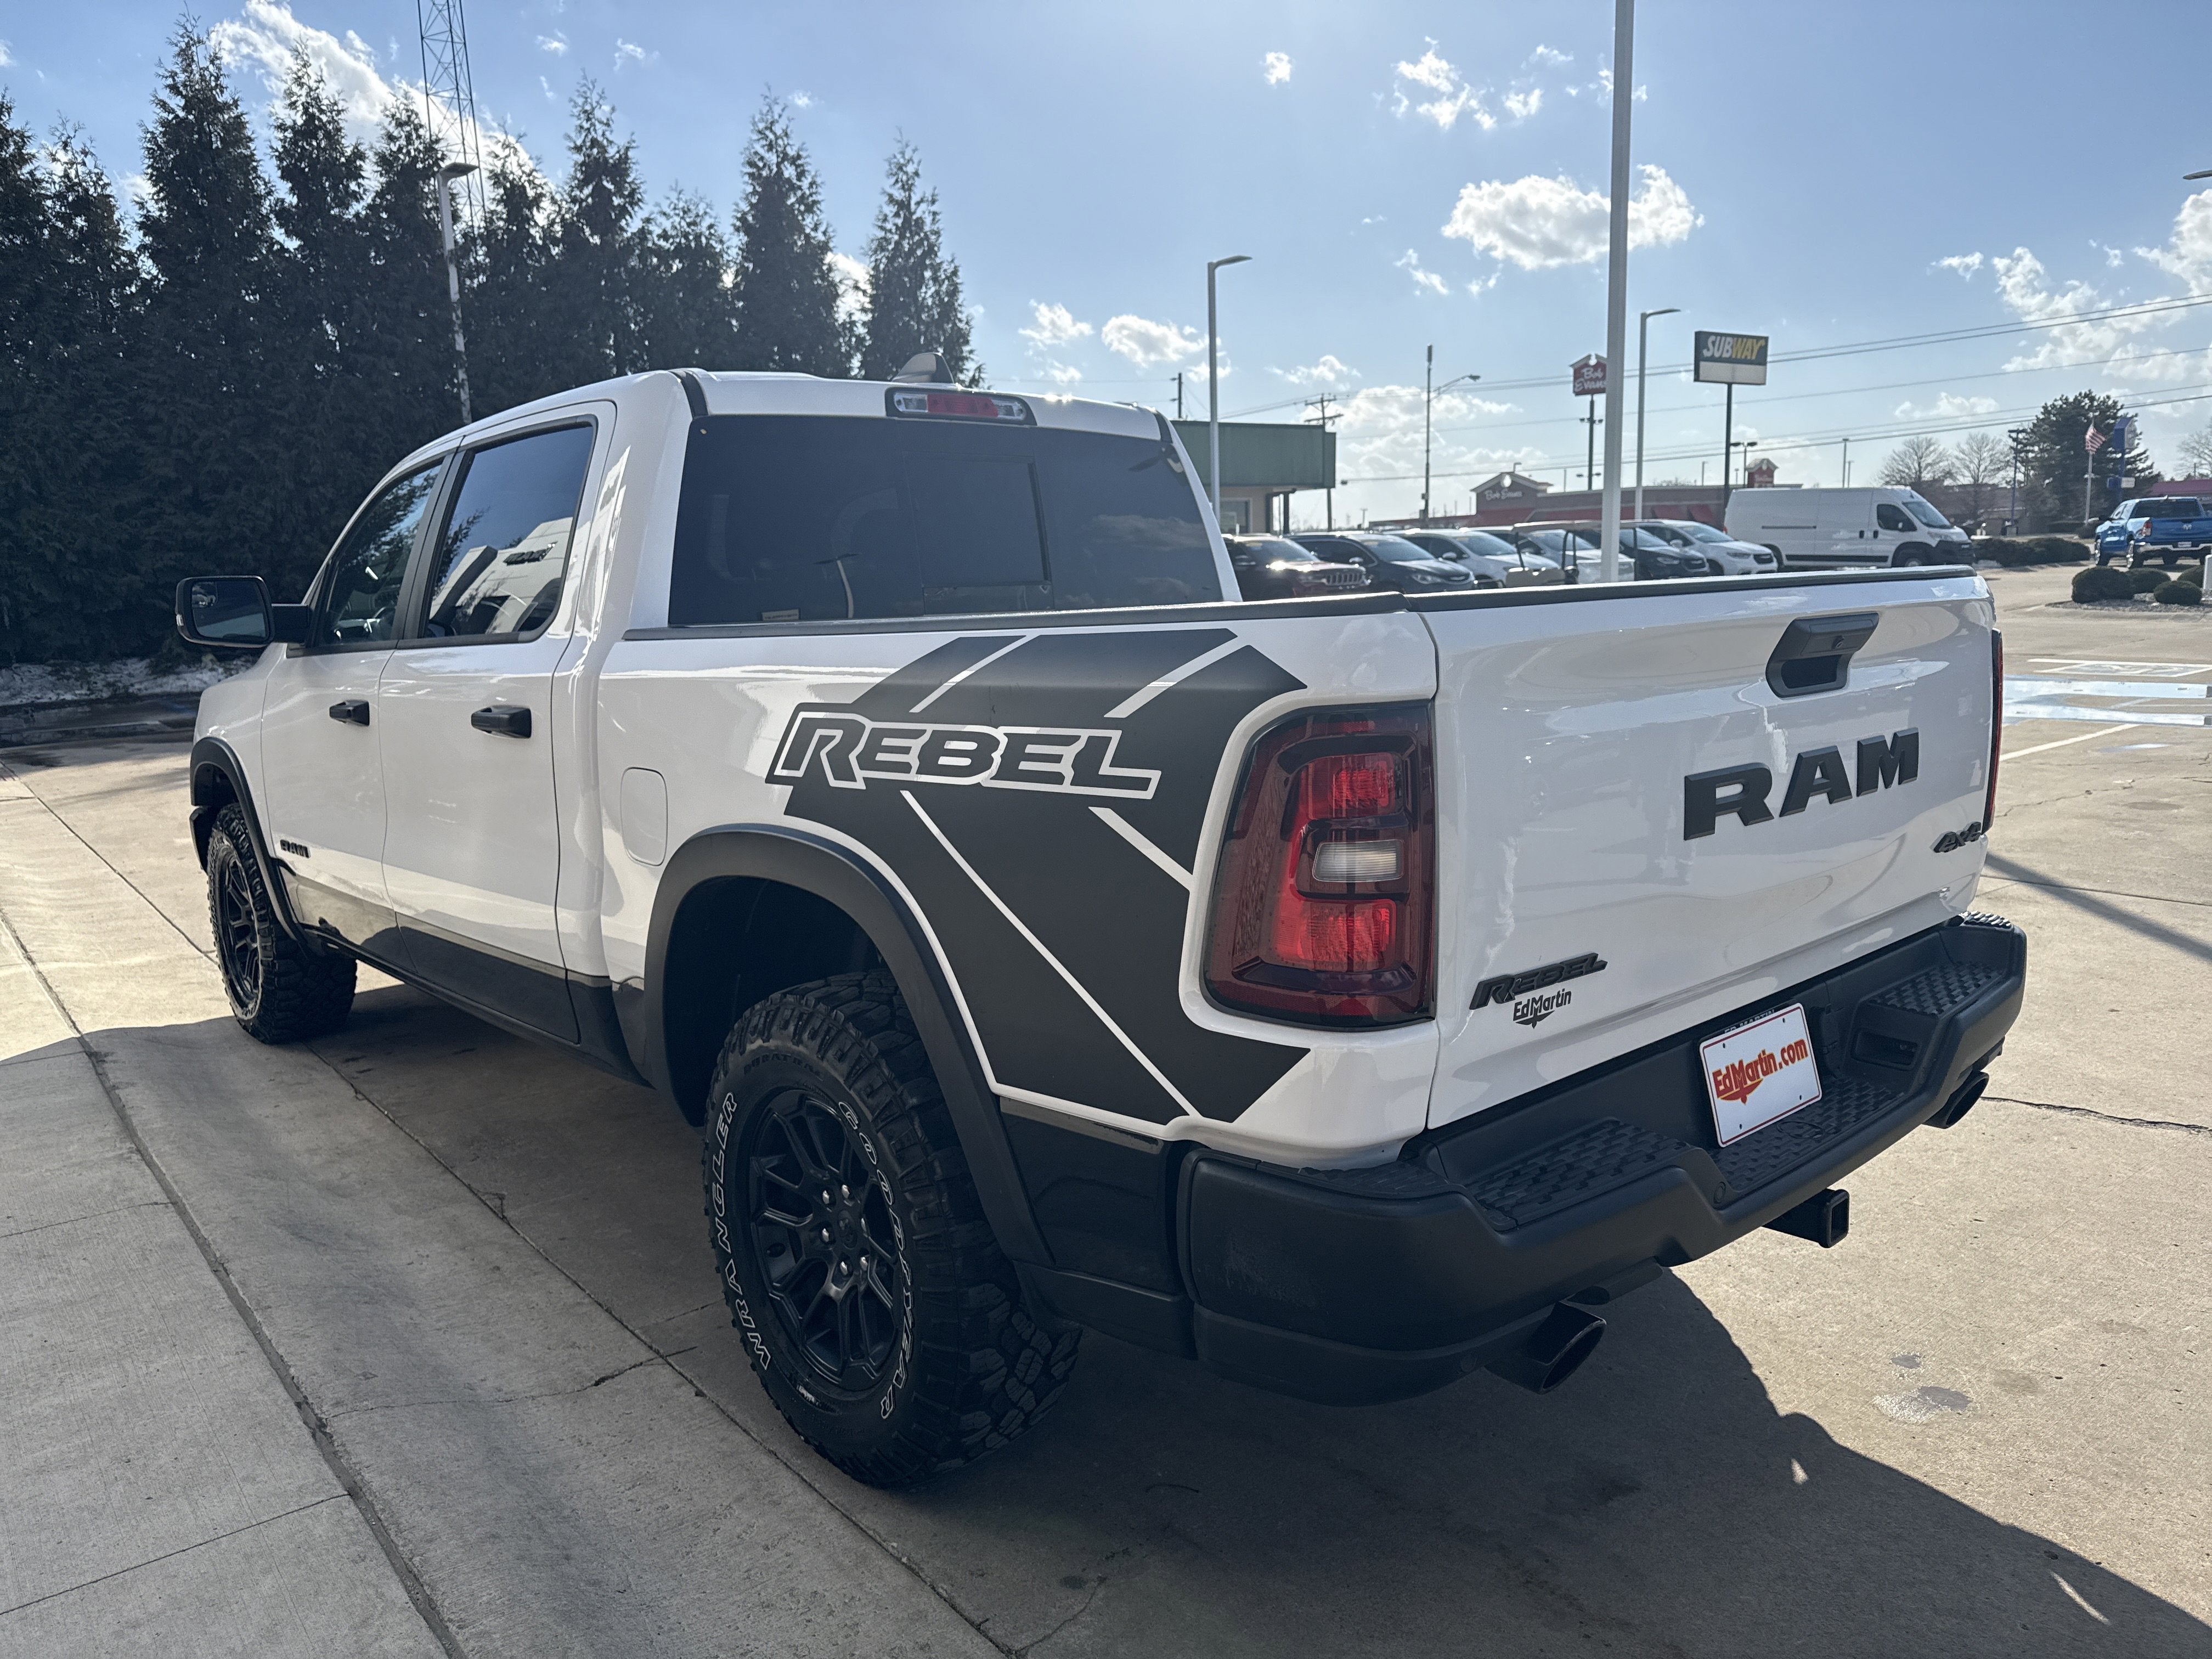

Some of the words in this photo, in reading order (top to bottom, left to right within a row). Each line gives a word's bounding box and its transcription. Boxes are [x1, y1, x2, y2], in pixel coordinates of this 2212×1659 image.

[1581, 367, 1603, 379] Bob
[1703, 335, 1765, 360] SUBWAY
[1485, 489, 1500, 500] Bob
[774, 711, 1162, 800] REBEL
[1684, 727, 1919, 841] RAM
[280, 839, 311, 859] RAM
[1469, 952, 1608, 1010] REBEL
[1513, 988, 1572, 1022] EdMartin
[1712, 1039, 1809, 1099] EdMartin.com
[713, 1092, 771, 1370] WRANGLER
[838, 1101, 913, 1420] GOODYEAR
